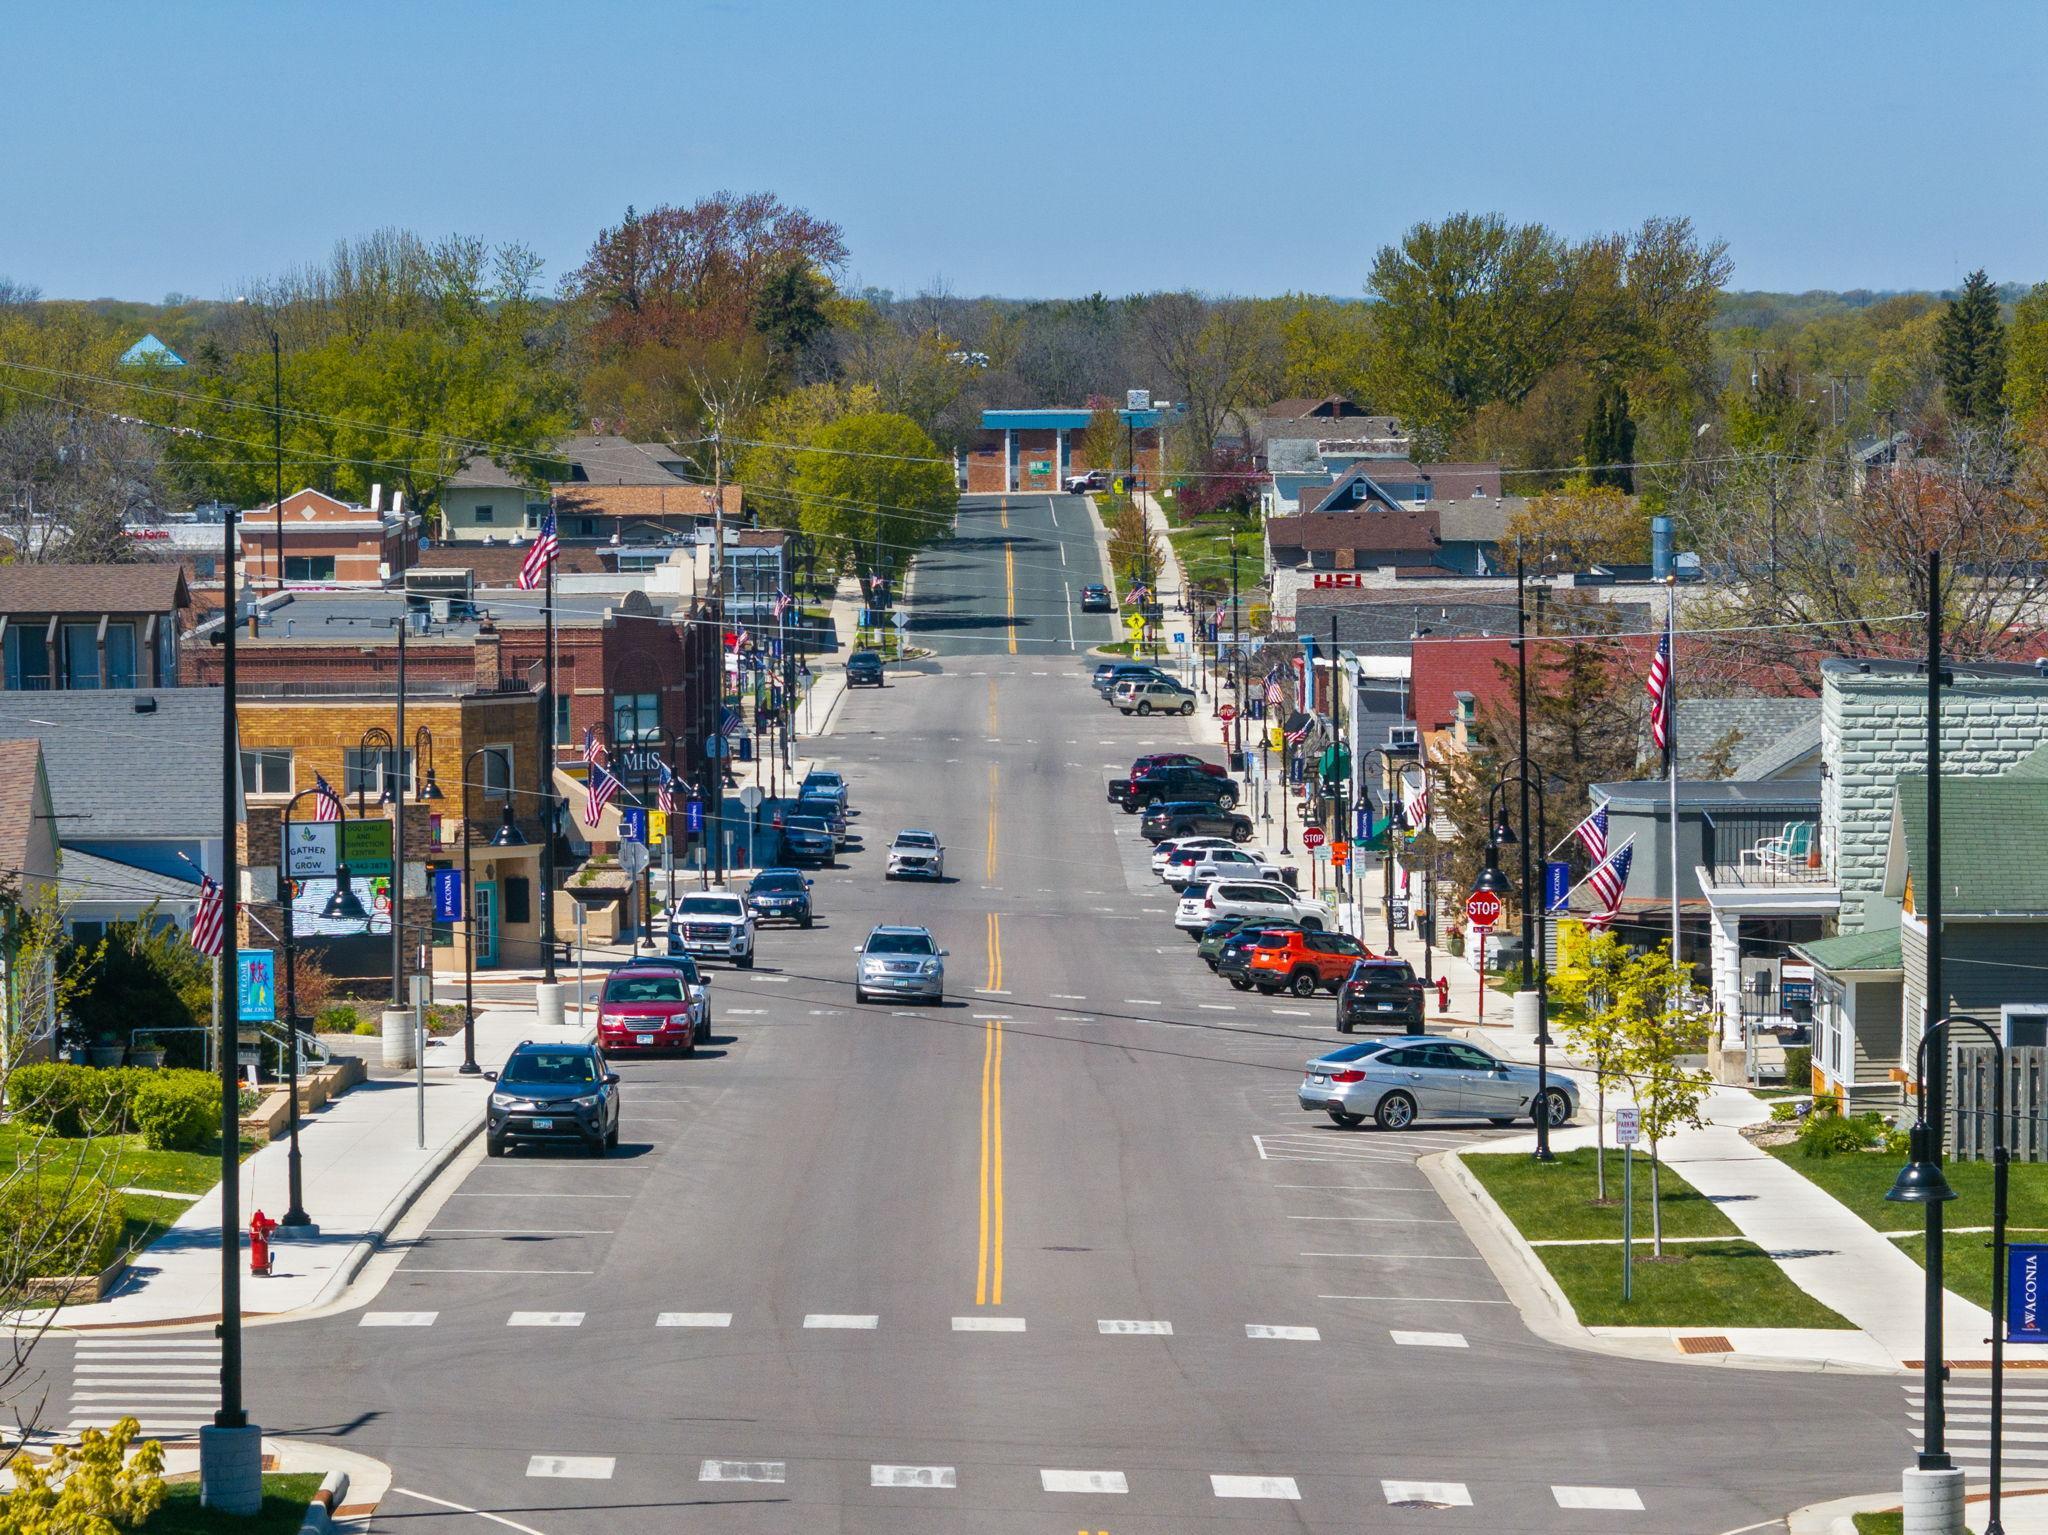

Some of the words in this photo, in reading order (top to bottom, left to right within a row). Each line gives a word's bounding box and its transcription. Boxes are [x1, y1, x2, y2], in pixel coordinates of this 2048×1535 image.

[624, 752, 660, 770] MHS
[1304, 834, 1324, 843] STOP
[290, 846, 326, 855] GATHER
[1469, 901, 1499, 915] STOP
[2025, 1255, 2037, 1324] WACONIA
